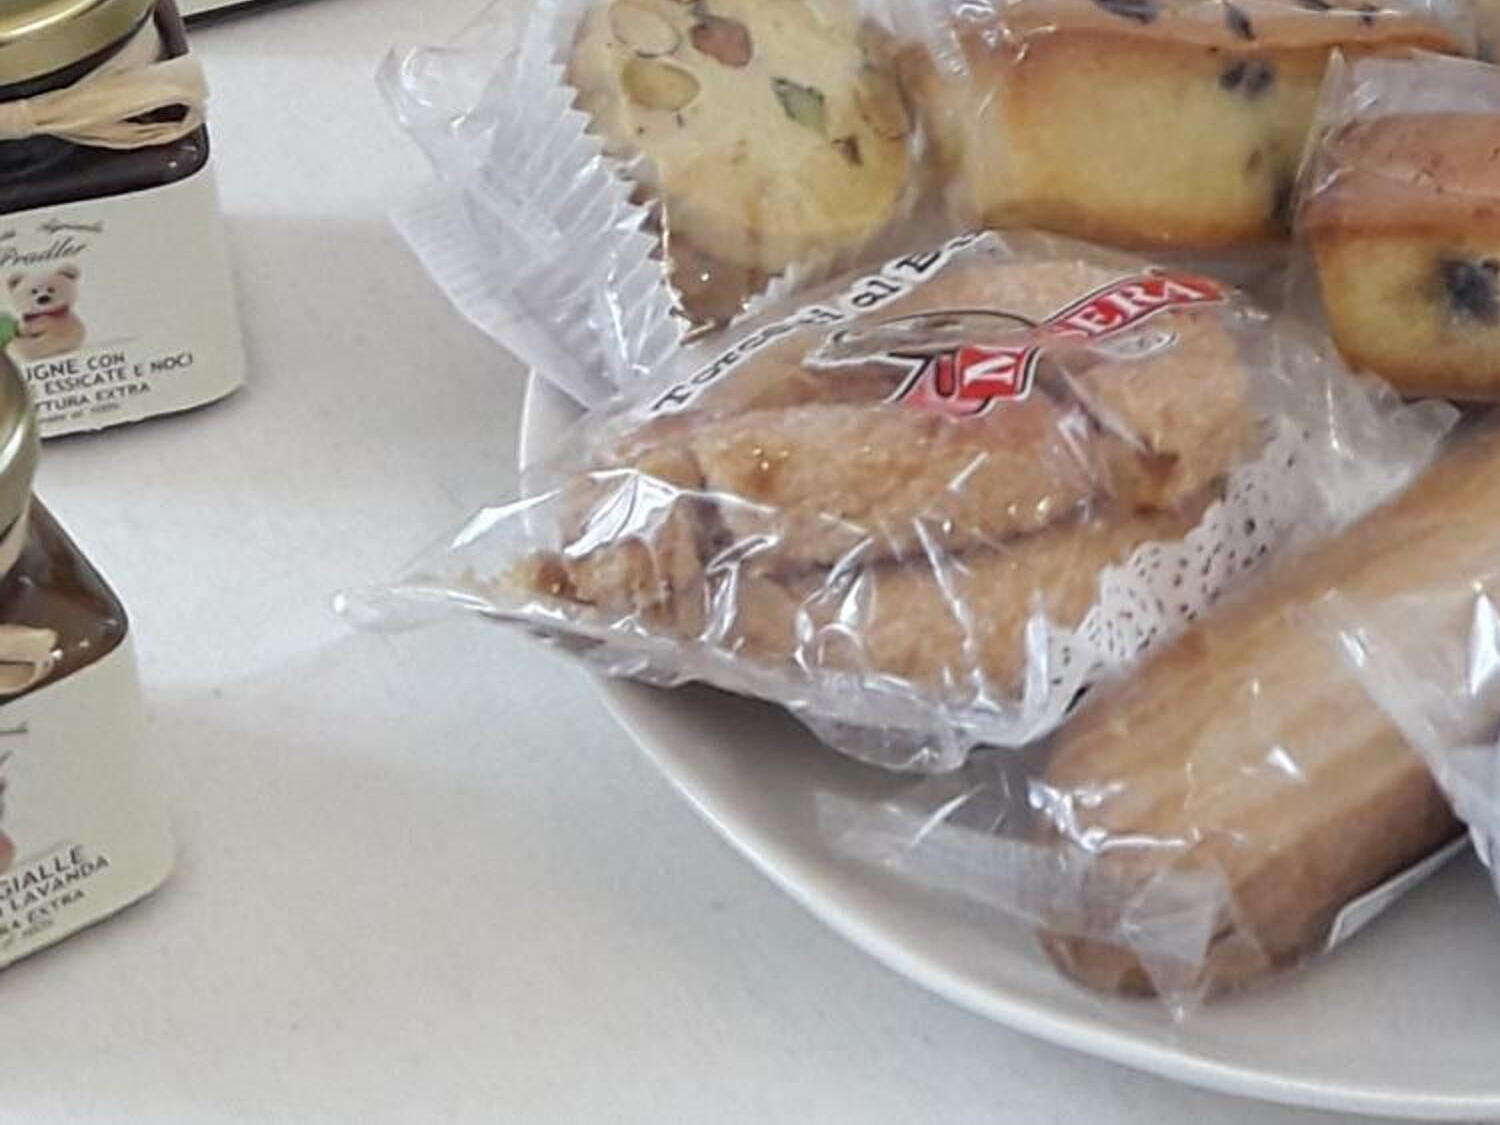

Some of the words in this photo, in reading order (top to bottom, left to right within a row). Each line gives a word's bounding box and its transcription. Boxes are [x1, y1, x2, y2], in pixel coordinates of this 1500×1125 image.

[87, 351, 125, 371] CON
[151, 351, 194, 373] NOCI
[96, 381, 151, 402] EXTRA
[10, 853, 110, 912] LAVANDA
